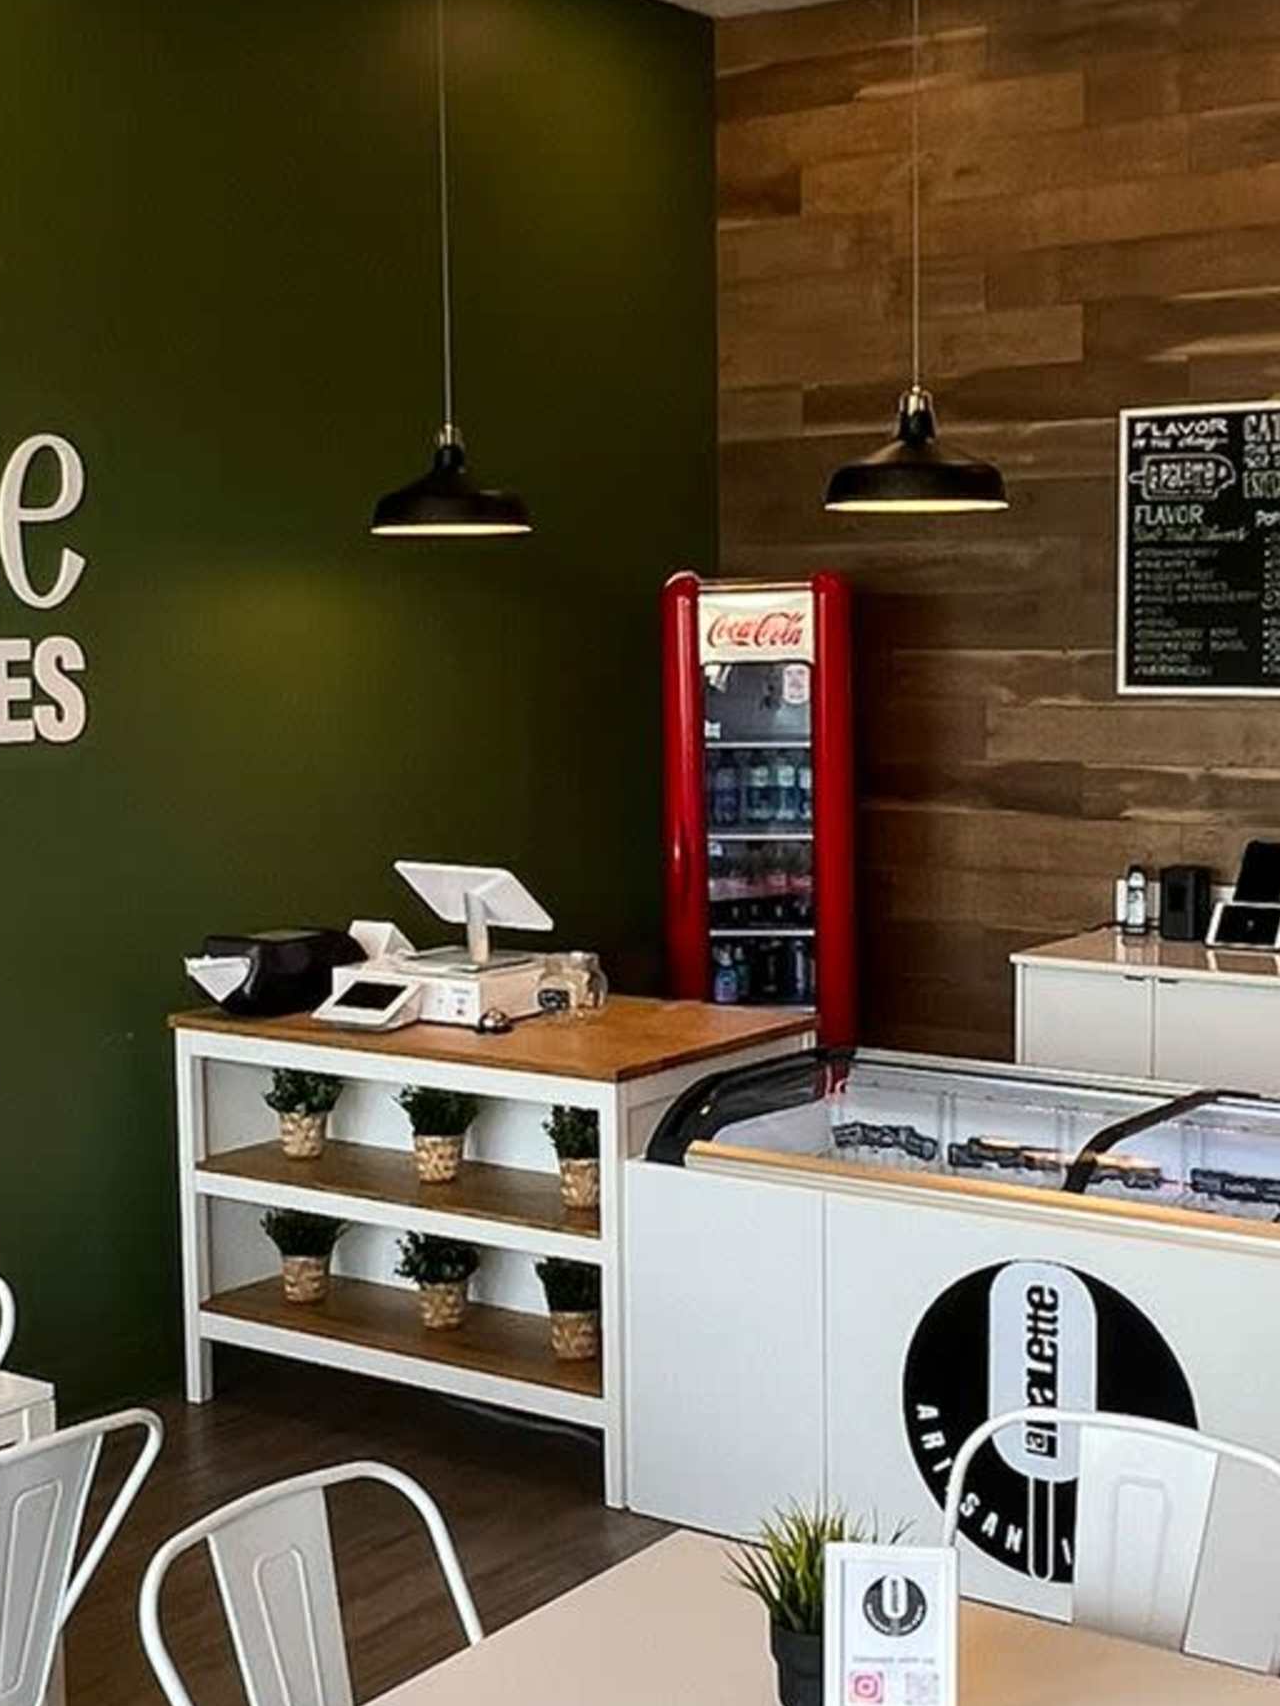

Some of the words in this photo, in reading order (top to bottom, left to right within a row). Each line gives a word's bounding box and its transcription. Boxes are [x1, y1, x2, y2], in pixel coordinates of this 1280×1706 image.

[1134, 417, 1228, 437] FLAVOR
[1134, 504, 1205, 526] FLAVOR
[915, 1403, 1024, 1553] ARTSAN
